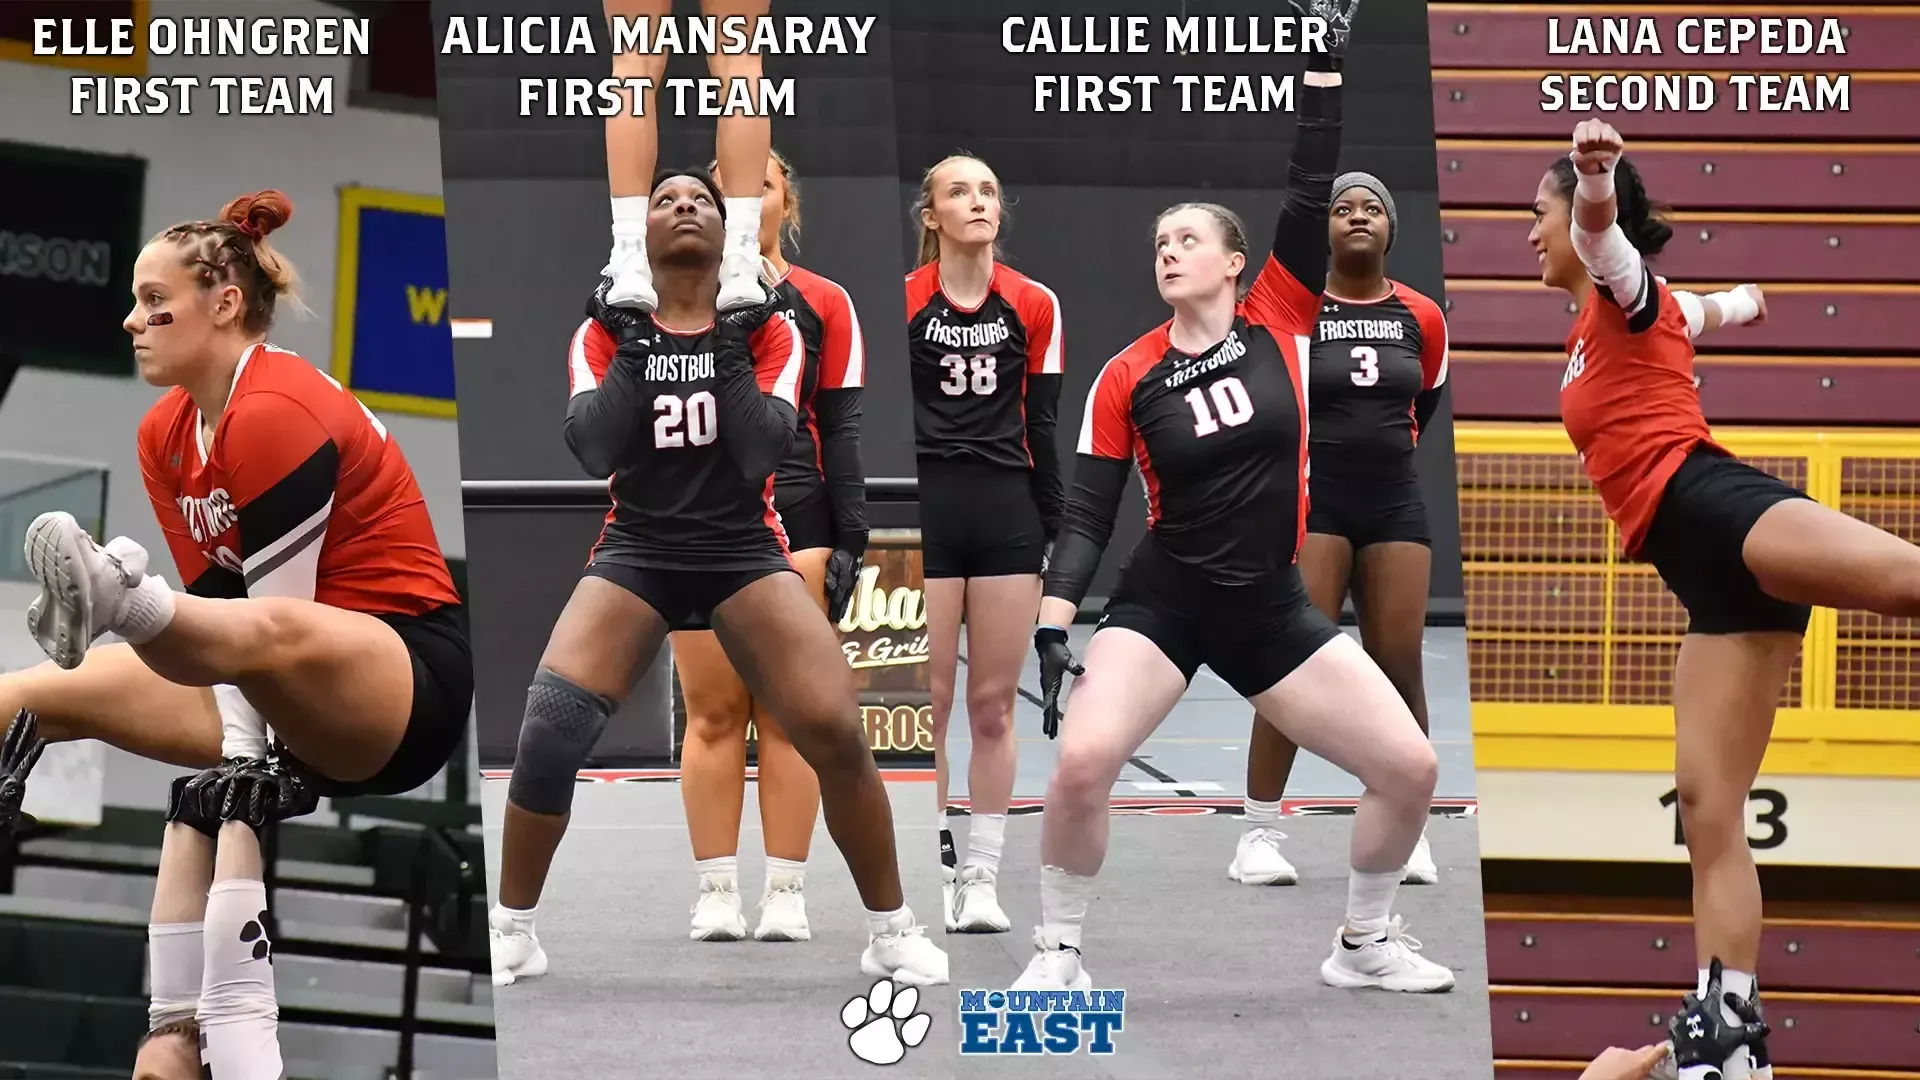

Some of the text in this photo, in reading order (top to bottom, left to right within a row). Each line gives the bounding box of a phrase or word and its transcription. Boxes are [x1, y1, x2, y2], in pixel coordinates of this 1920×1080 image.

[1320, 319, 1404, 341] FROSTBURG
[939, 354, 997, 396] 38
[1350, 345, 1380, 387] 3
[653, 390, 717, 449] 20
[1184, 376, 1255, 438] 10
[859, 705, 935, 751] ROS
